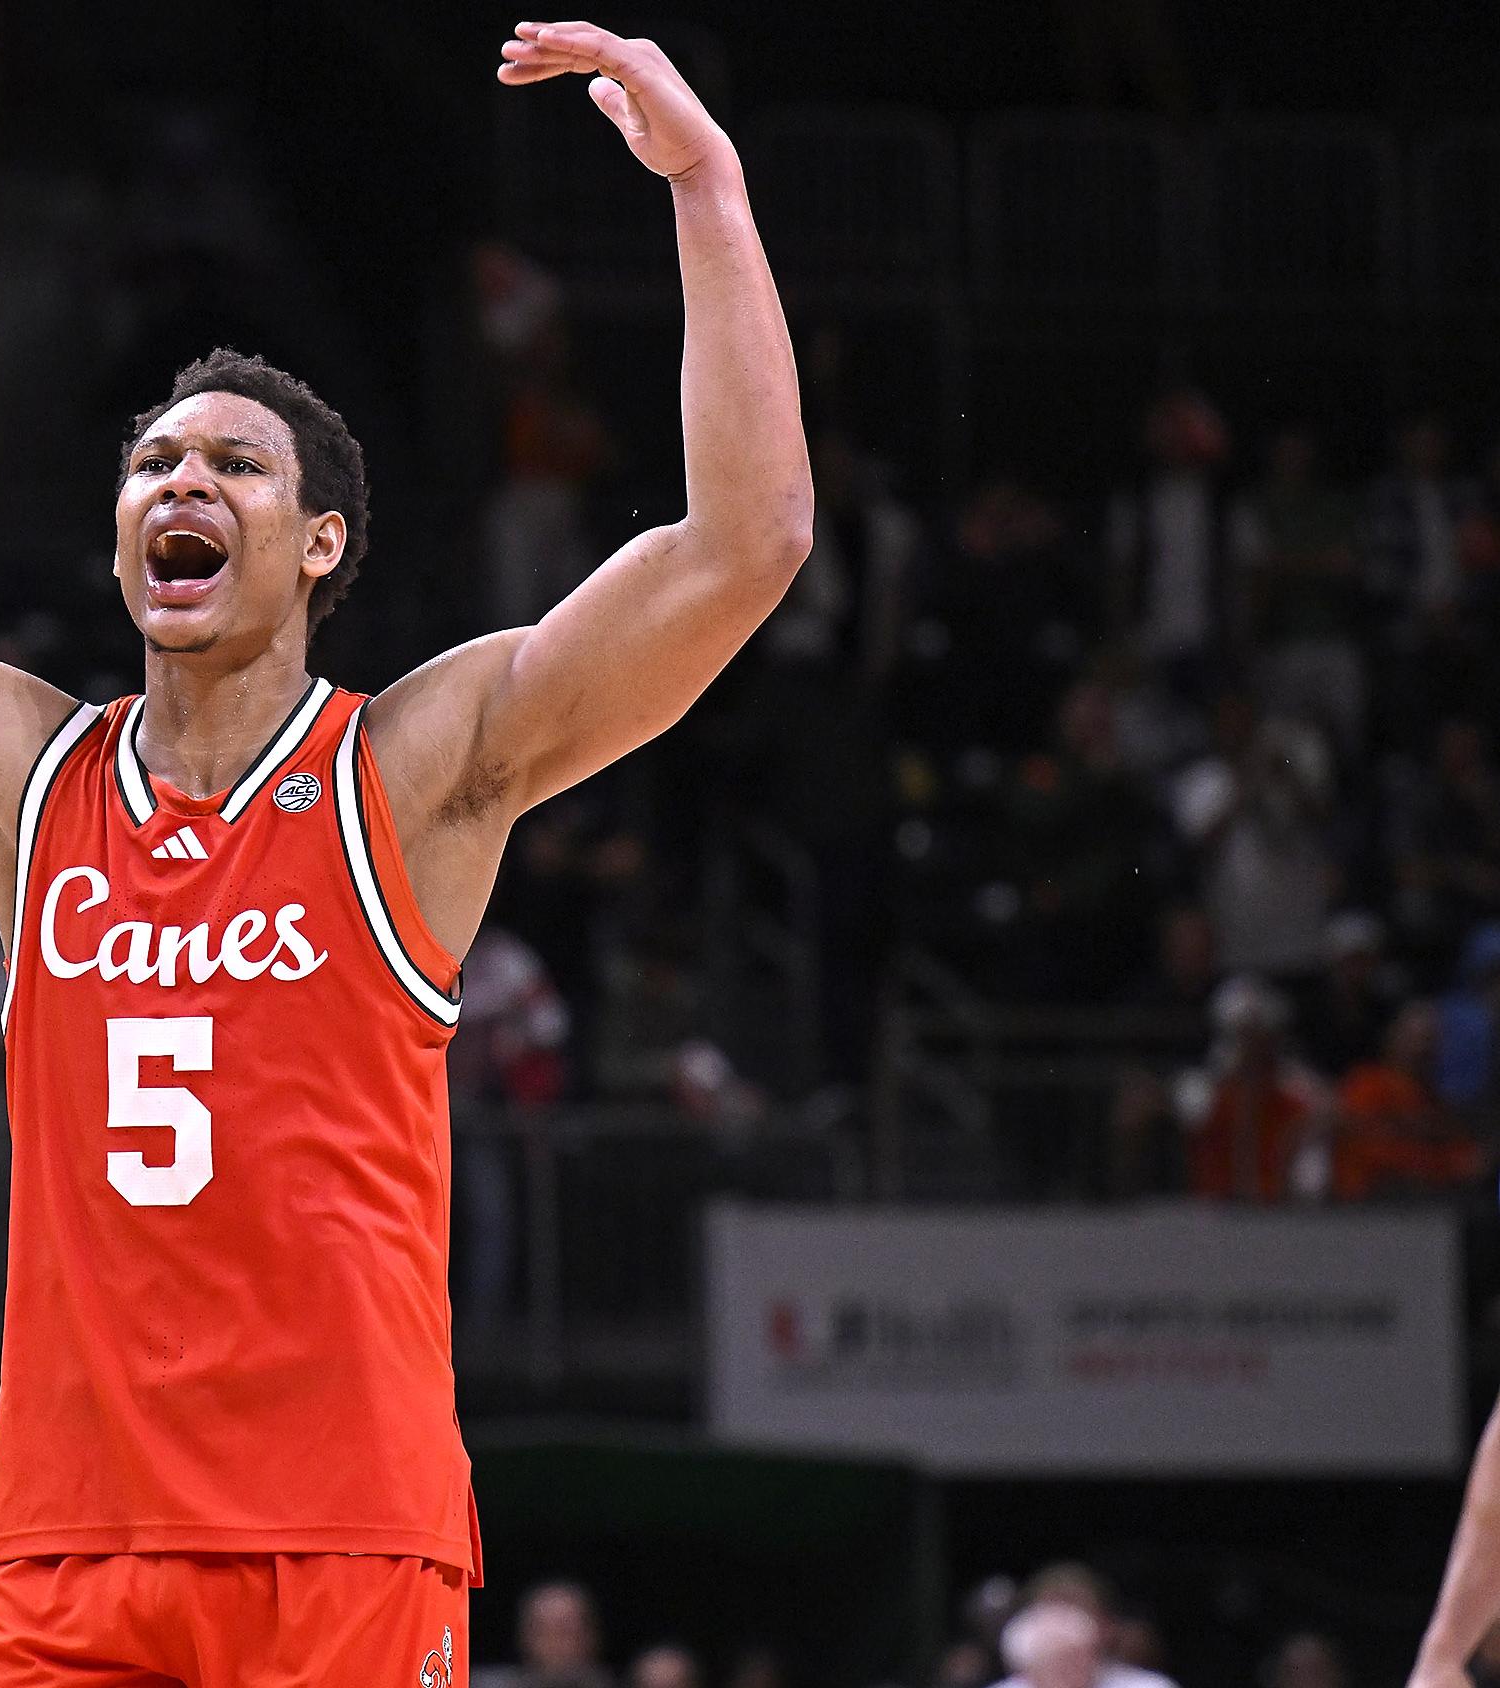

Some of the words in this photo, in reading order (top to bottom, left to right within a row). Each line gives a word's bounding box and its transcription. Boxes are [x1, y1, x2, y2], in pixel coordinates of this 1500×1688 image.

[280, 785, 318, 796] ACC
[41, 866, 328, 986] Canes
[106, 1016, 213, 1206] 5
